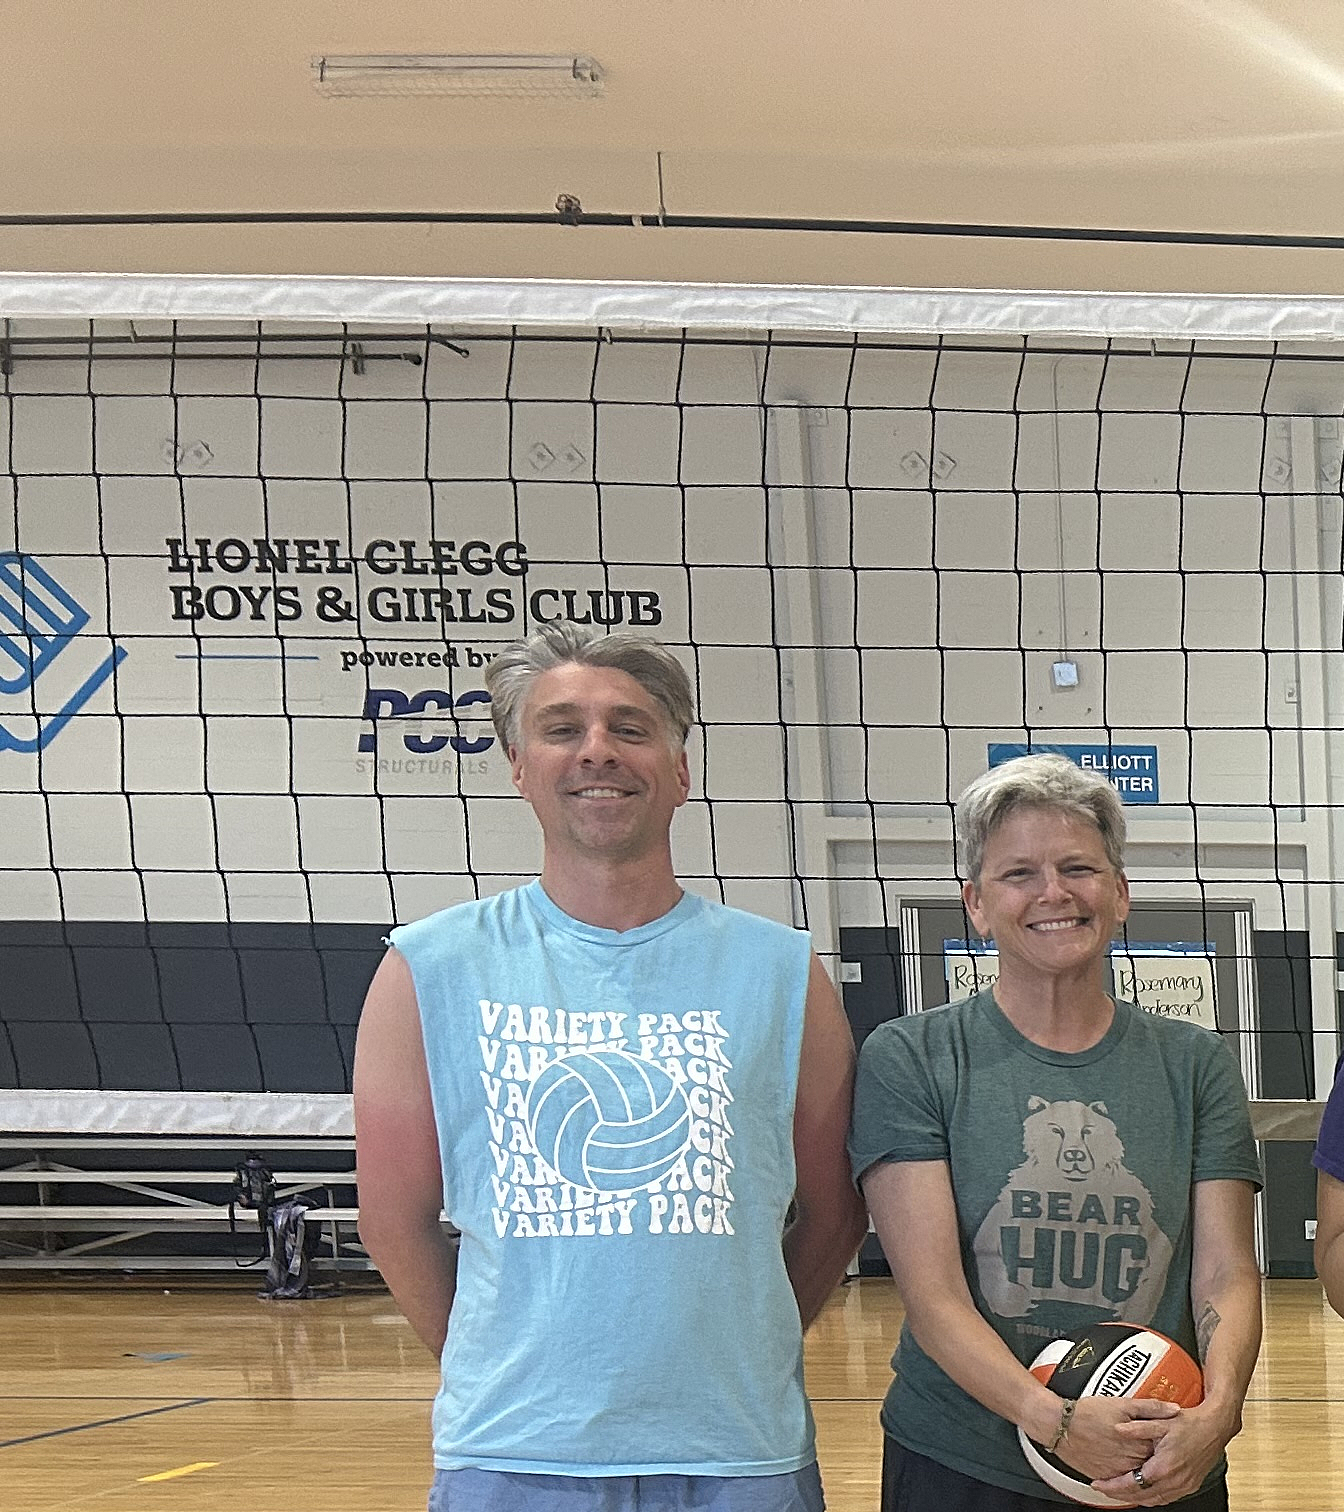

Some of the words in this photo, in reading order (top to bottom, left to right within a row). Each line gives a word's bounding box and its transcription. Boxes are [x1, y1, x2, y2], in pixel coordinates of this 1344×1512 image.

[166, 537, 356, 574] LIONEL
[364, 540, 529, 576] CLEGG
[170, 584, 303, 621] BOYS
[316, 586, 357, 622] &
[367, 586, 516, 624] GIRLS
[530, 588, 663, 627] CLUB
[340, 647, 460, 671] powered
[355, 759, 489, 775] STRUCTURLS
[1081, 755, 1153, 770] ELLIOTT
[1110, 777, 1153, 791] NTER
[954, 964, 999, 989] Rosem
[1120, 969, 1205, 1001] Rosemary
[478, 999, 630, 1045] VARIETY
[637, 1010, 730, 1037] PACK
[491, 1200, 638, 1239] VARIETY
[648, 1194, 735, 1236] PACK
[1010, 1189, 1141, 1226] BEAR
[1000, 1225, 1150, 1302] HUG
